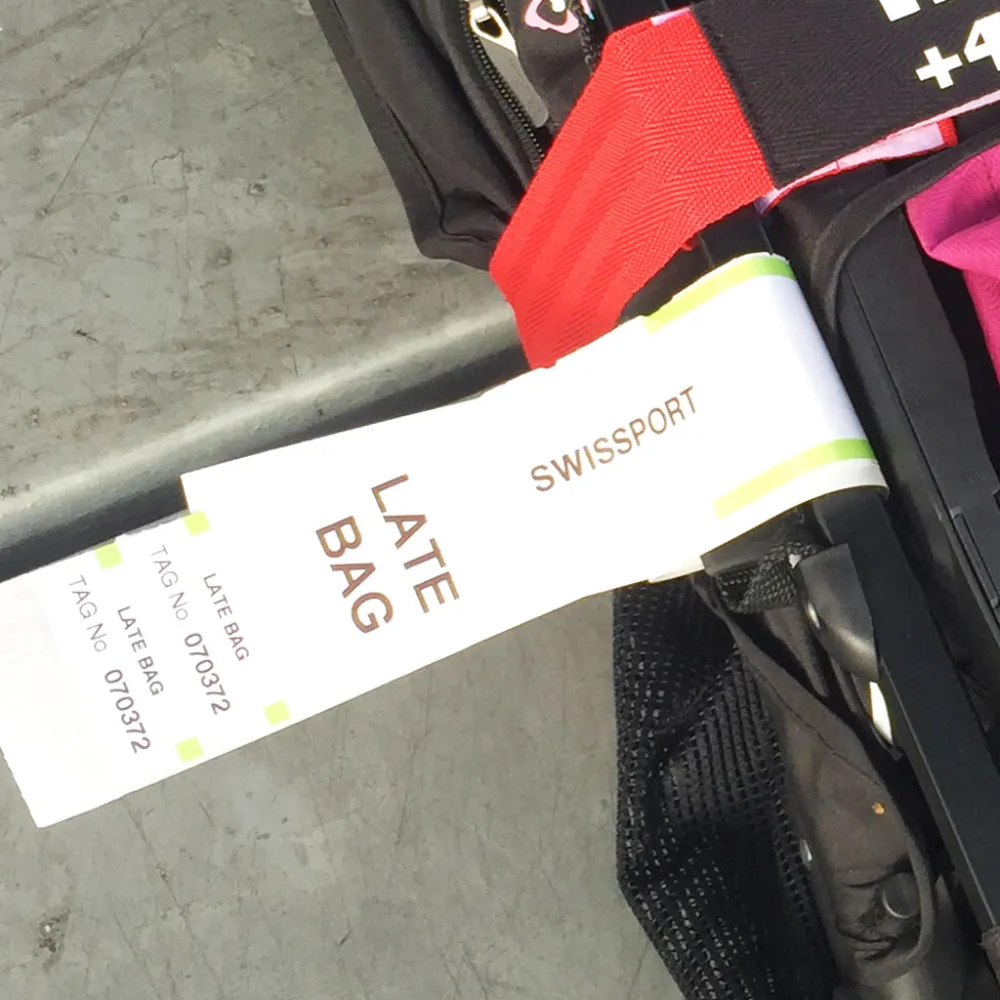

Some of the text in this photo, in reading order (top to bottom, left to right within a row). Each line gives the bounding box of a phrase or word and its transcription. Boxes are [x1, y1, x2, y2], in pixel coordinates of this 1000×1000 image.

[530, 386, 698, 492] SWISSPORT
[315, 515, 393, 635] BAG
[371, 474, 460, 614] LATE
[69, 574, 151, 754] TAG No 070372
[117, 605, 164, 696] LATE BAG
[151, 544, 231, 715] TAG No 070372
[203, 573, 250, 661] LATE BAG
